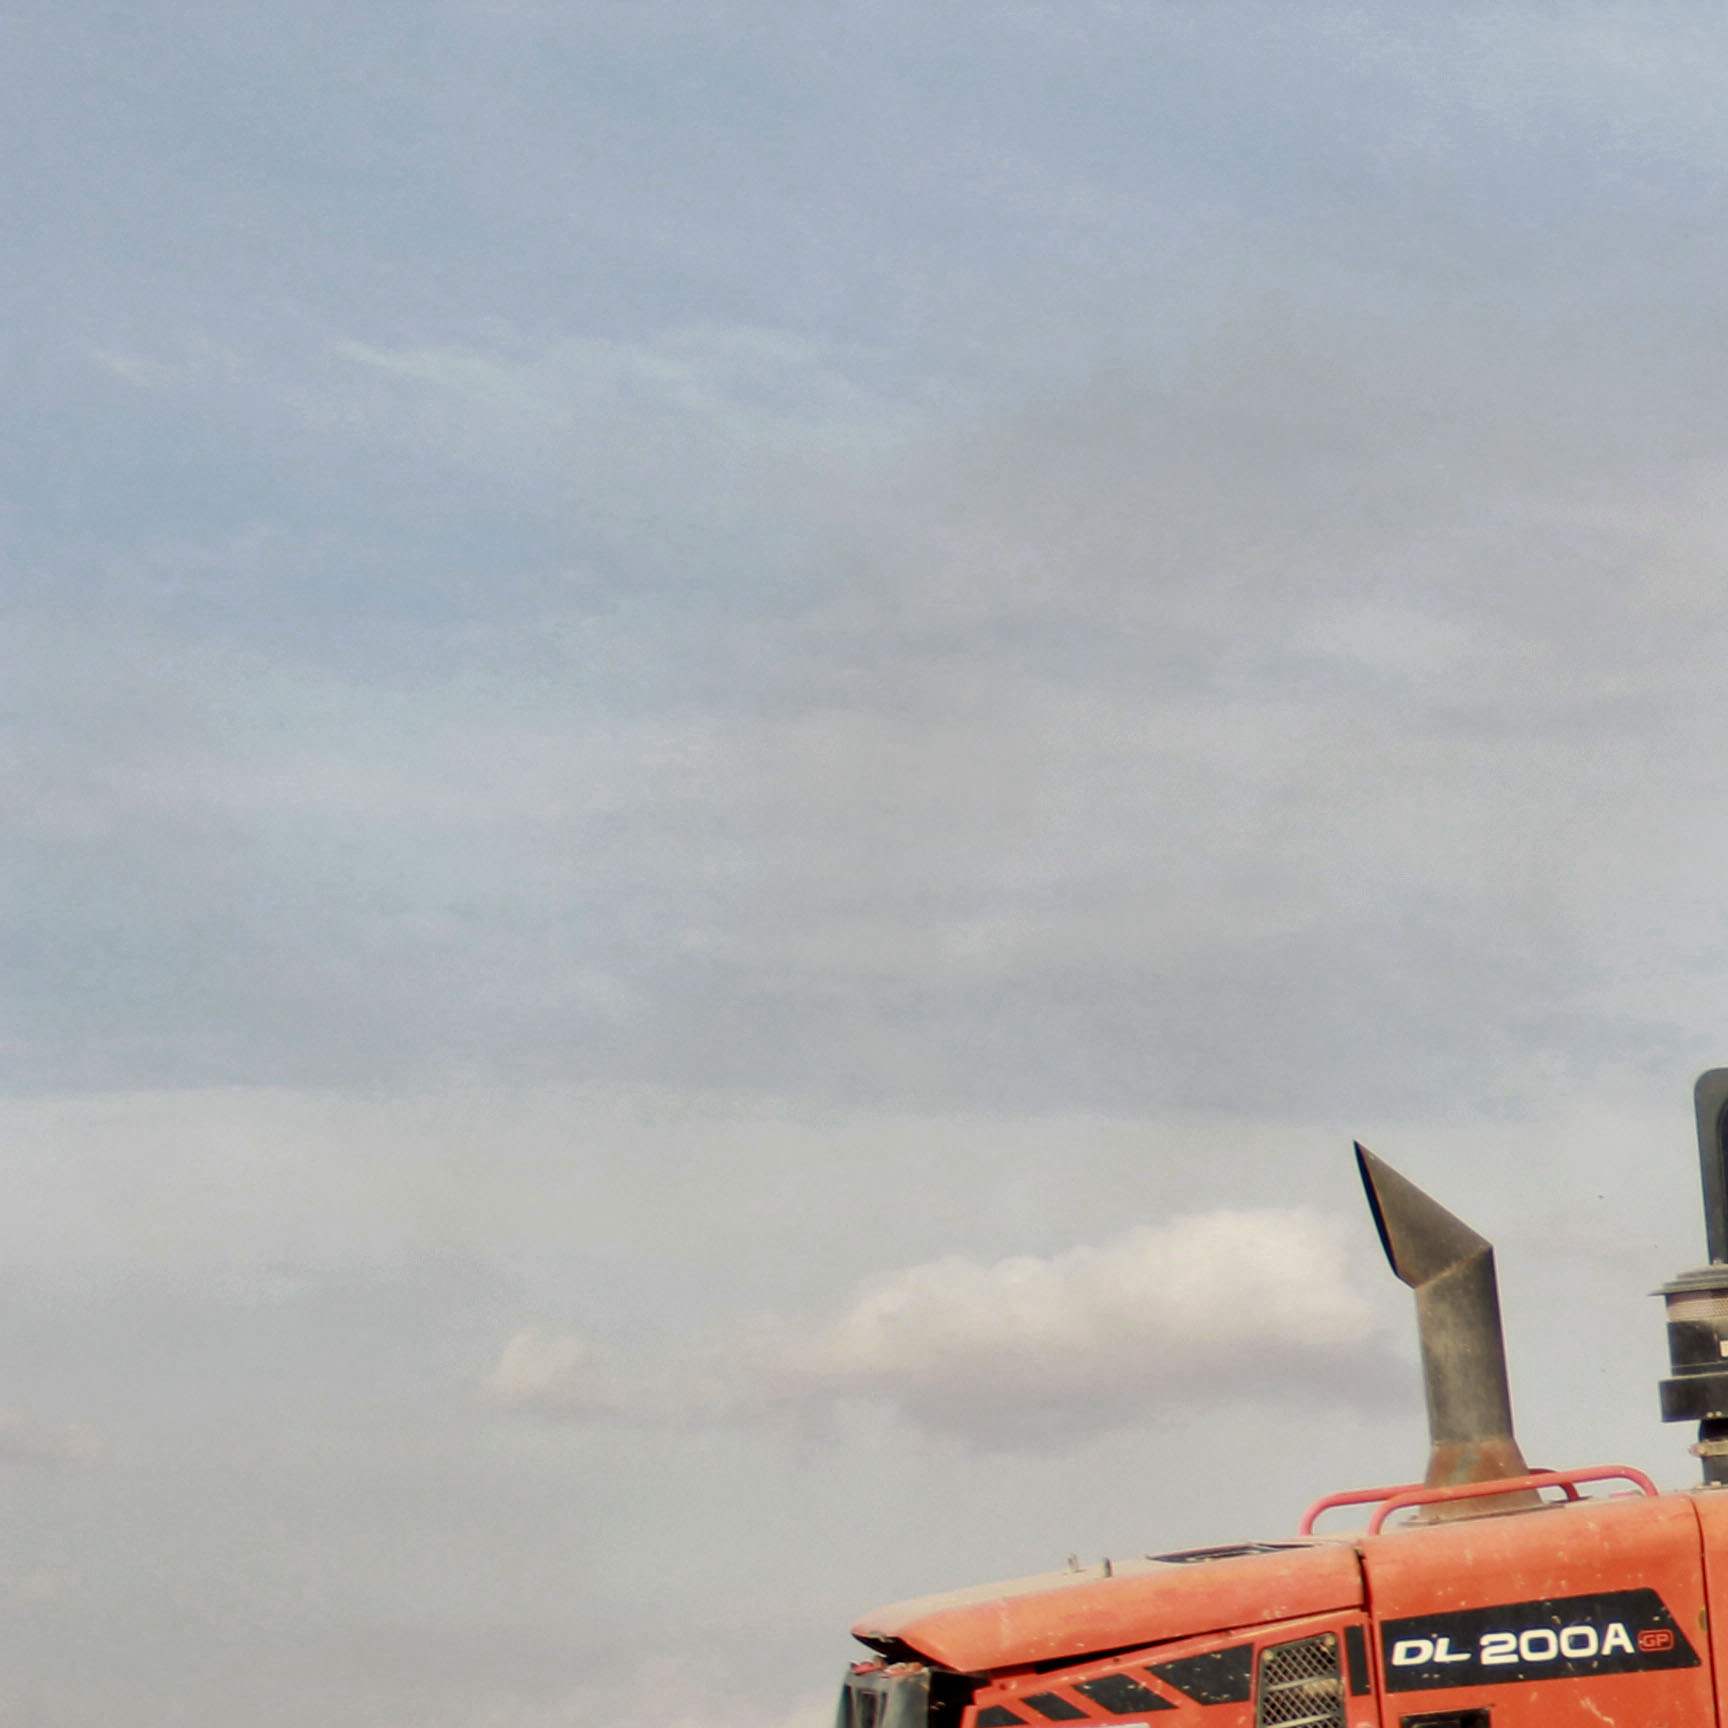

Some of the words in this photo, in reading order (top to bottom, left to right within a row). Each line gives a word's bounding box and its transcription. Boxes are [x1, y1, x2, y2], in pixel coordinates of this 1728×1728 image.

[1391, 1637, 1472, 1666] DL
[1479, 1622, 1635, 1666] 200A
[1641, 1632, 1671, 1649] GP
